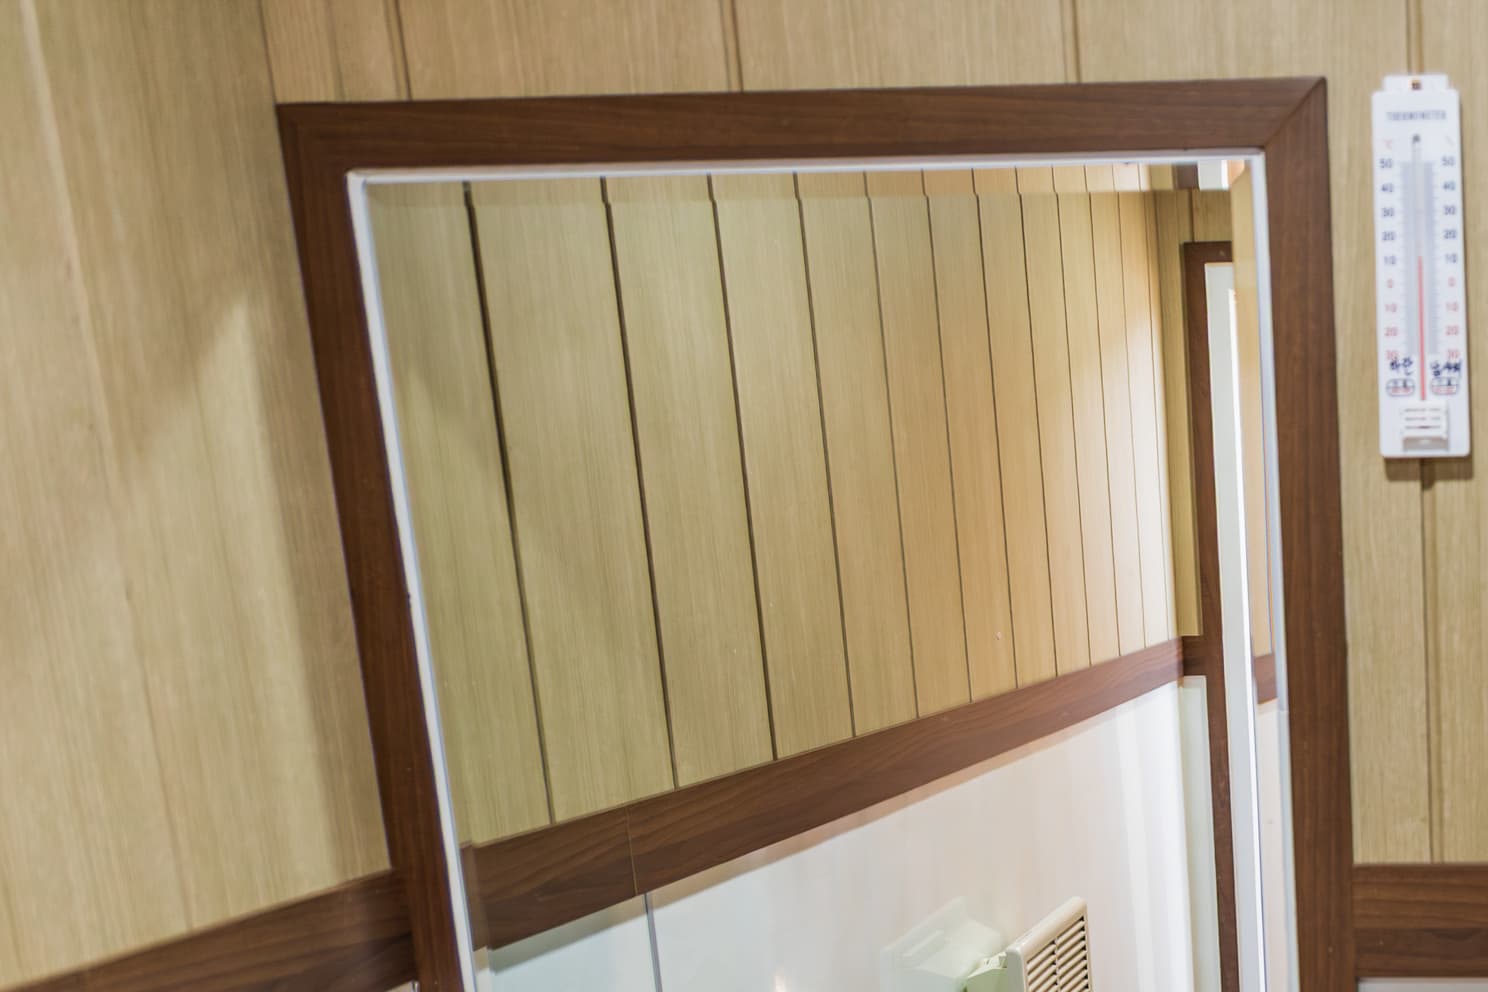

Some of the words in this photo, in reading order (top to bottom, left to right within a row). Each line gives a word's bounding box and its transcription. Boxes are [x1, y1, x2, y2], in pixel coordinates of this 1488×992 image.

[1379, 158, 1393, 169] 50
[1441, 156, 1455, 167] 50
[1381, 183, 1394, 193] 40
[1442, 181, 1456, 191] 40
[1381, 207, 1395, 217] 30
[1443, 205, 1456, 215] 30
[1382, 231, 1395, 241] 20
[1443, 229, 1457, 239] 20
[1384, 255, 1396, 265] 10
[1445, 253, 1458, 264] 10
[1384, 303, 1397, 313] 10
[1446, 301, 1459, 312] 10
[1384, 326, 1398, 337] 20
[1445, 325, 1460, 335] 20
